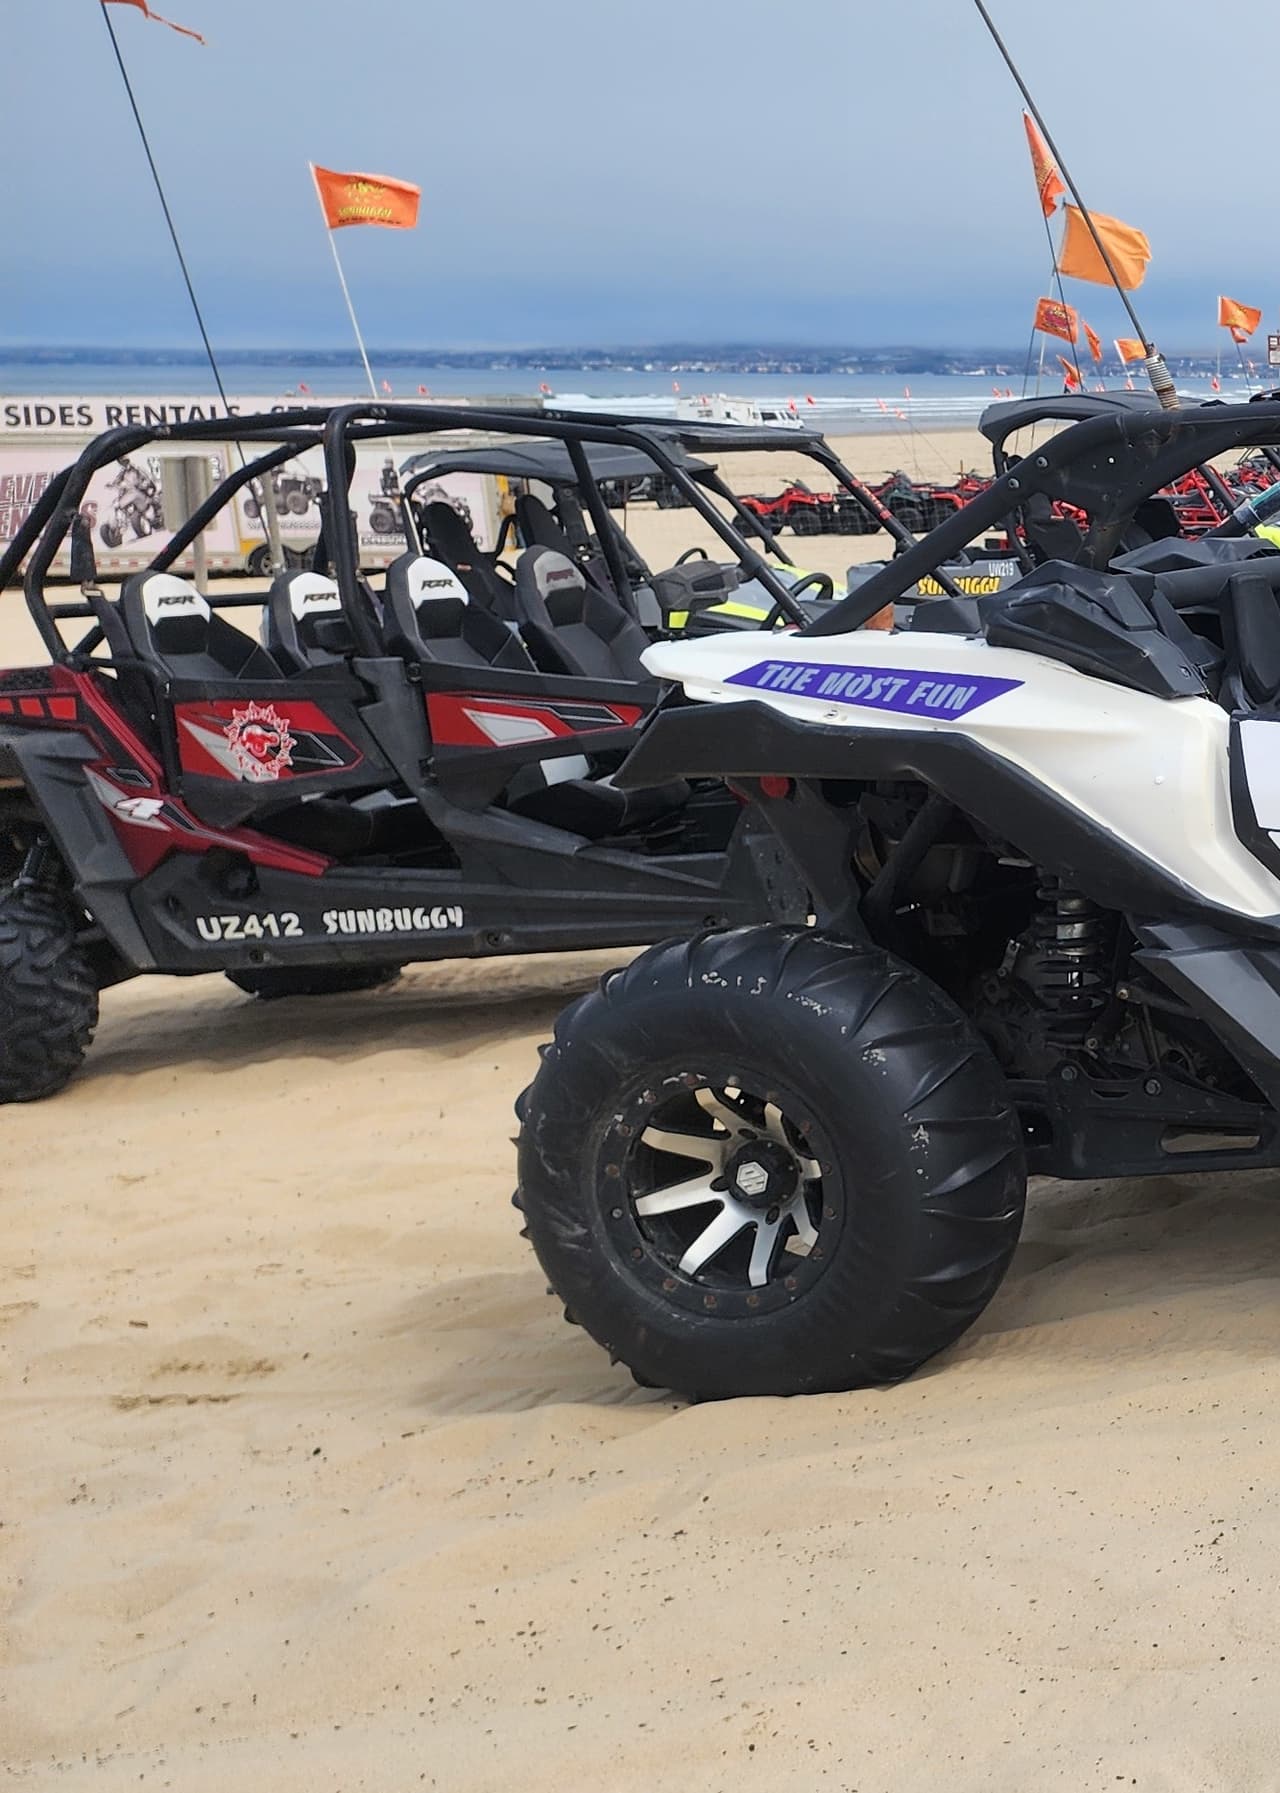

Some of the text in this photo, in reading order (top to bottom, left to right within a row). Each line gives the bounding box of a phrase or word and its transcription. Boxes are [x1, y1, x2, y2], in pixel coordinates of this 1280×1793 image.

[4, 405, 94, 427] SIDES
[421, 579, 454, 591] RZR
[757, 664, 978, 711] THE MOST FUN
[196, 905, 464, 941] UZ412 SUNBUGGY
